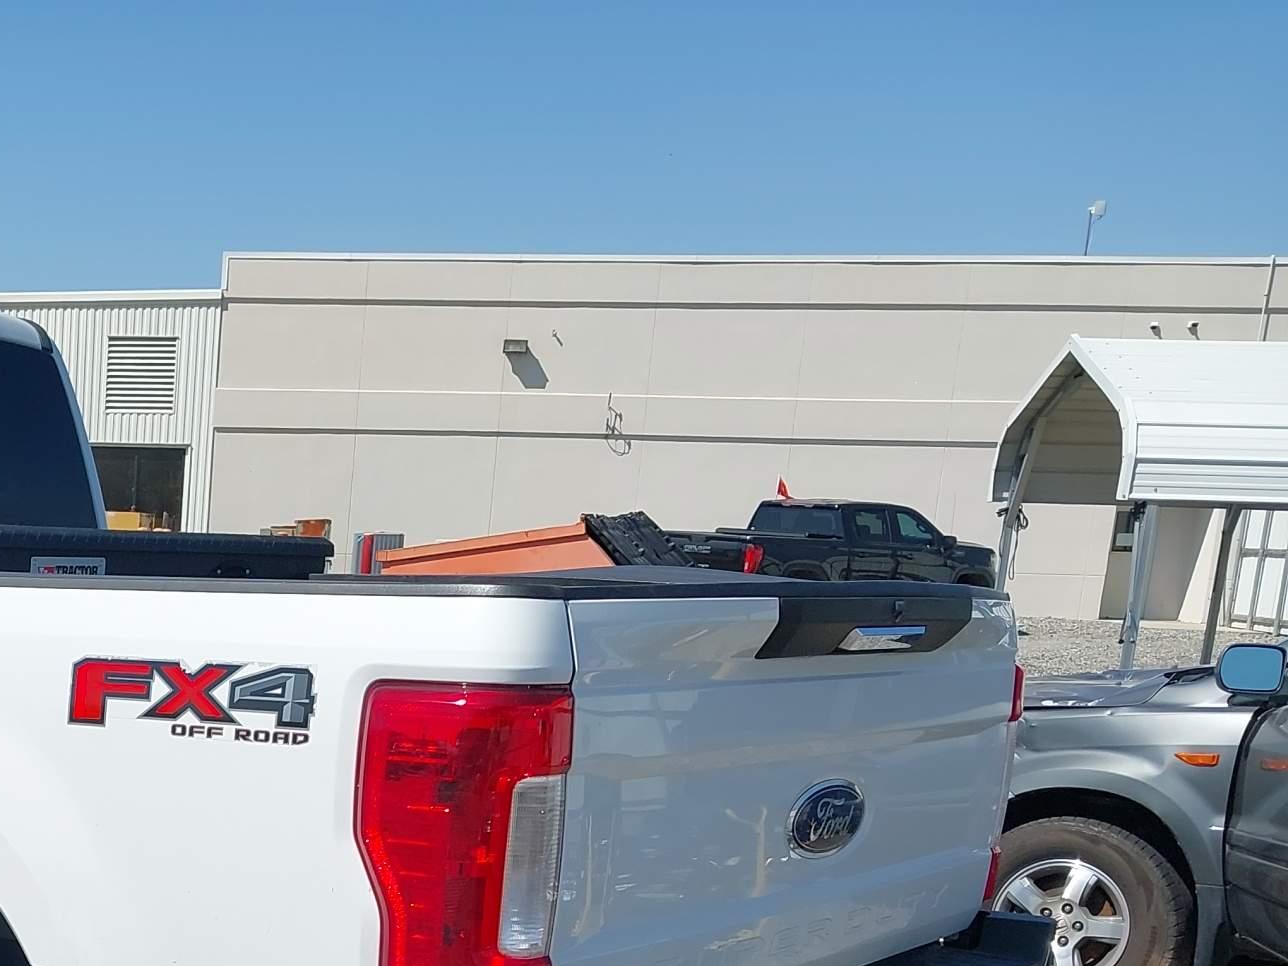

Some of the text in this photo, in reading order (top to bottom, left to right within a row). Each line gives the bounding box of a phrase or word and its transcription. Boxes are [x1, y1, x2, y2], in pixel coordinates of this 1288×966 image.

[56, 565, 98, 575] TRACTOR
[68, 656, 316, 730] FX4
[171, 724, 309, 746] OFF ROAD
[808, 797, 855, 841] Ford
